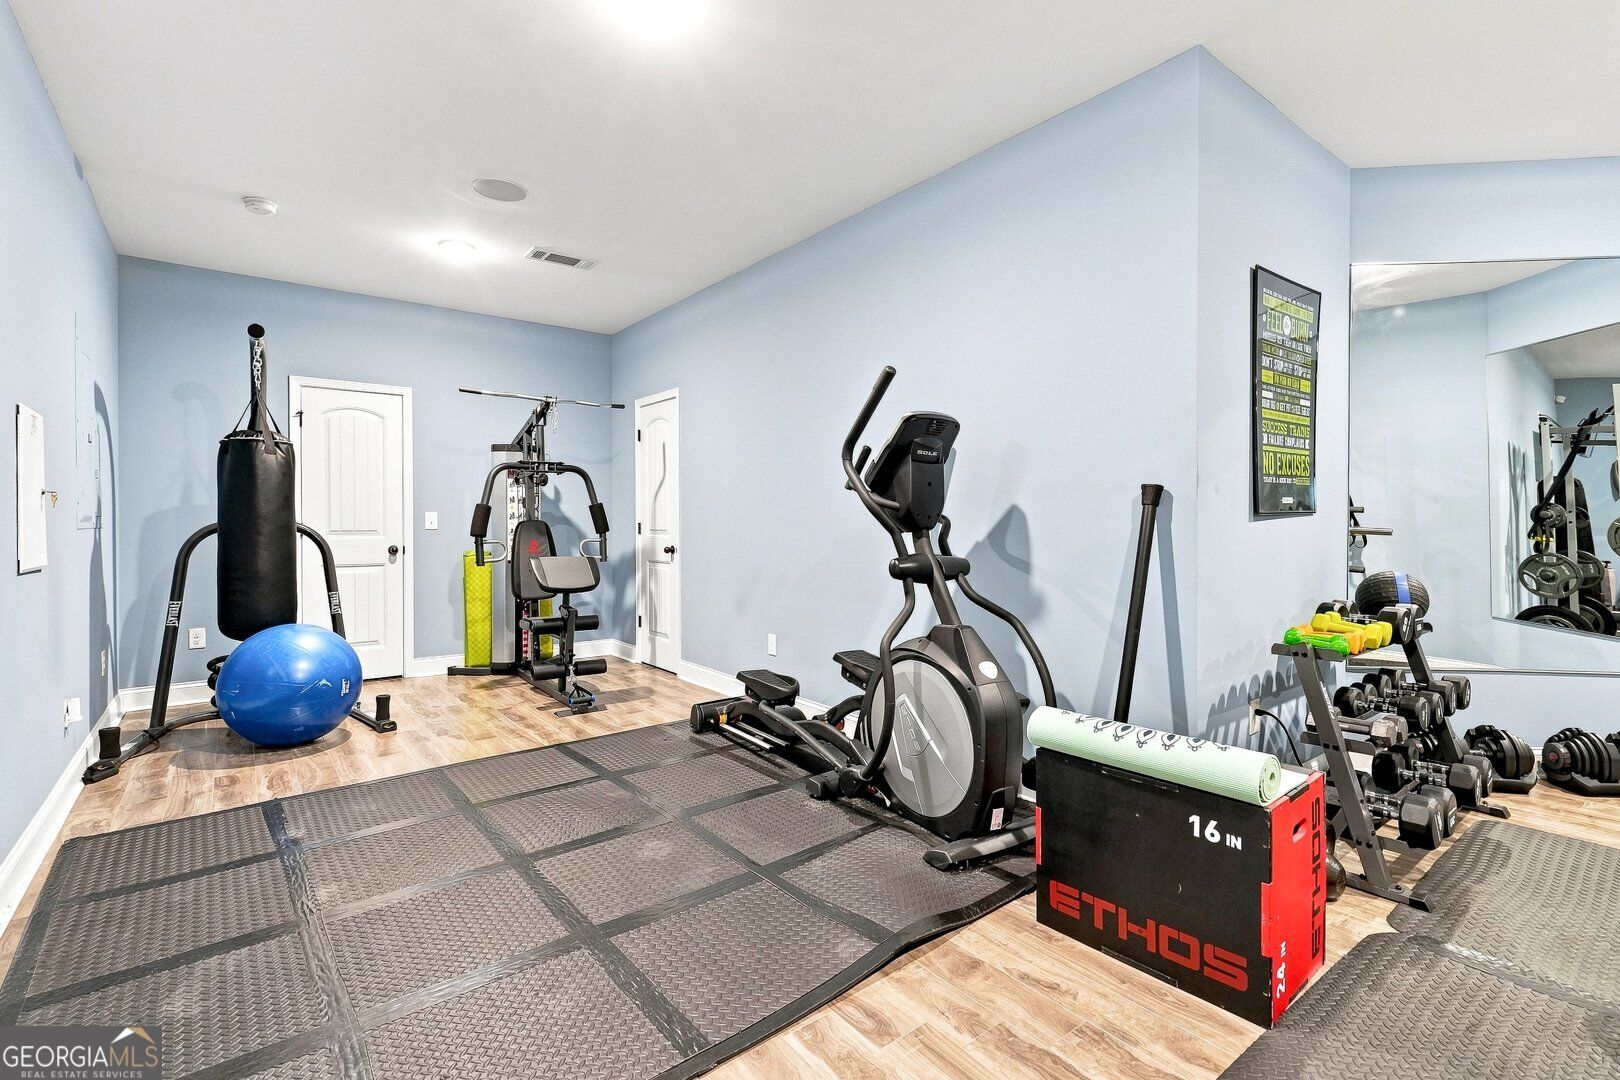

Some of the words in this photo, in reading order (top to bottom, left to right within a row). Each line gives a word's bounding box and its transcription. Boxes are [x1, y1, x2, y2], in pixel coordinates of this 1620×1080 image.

[1262, 420, 1287, 435] SUCCESS
[1263, 451, 1274, 475] NO
[1277, 454, 1310, 477] EXCUSES
[1188, 815, 1221, 843] 16
[1226, 833, 1242, 850] IN
[1311, 796, 1320, 960] ETHOS
[1049, 880, 1249, 992] ETHOS
[1276, 962, 1286, 998] 24
